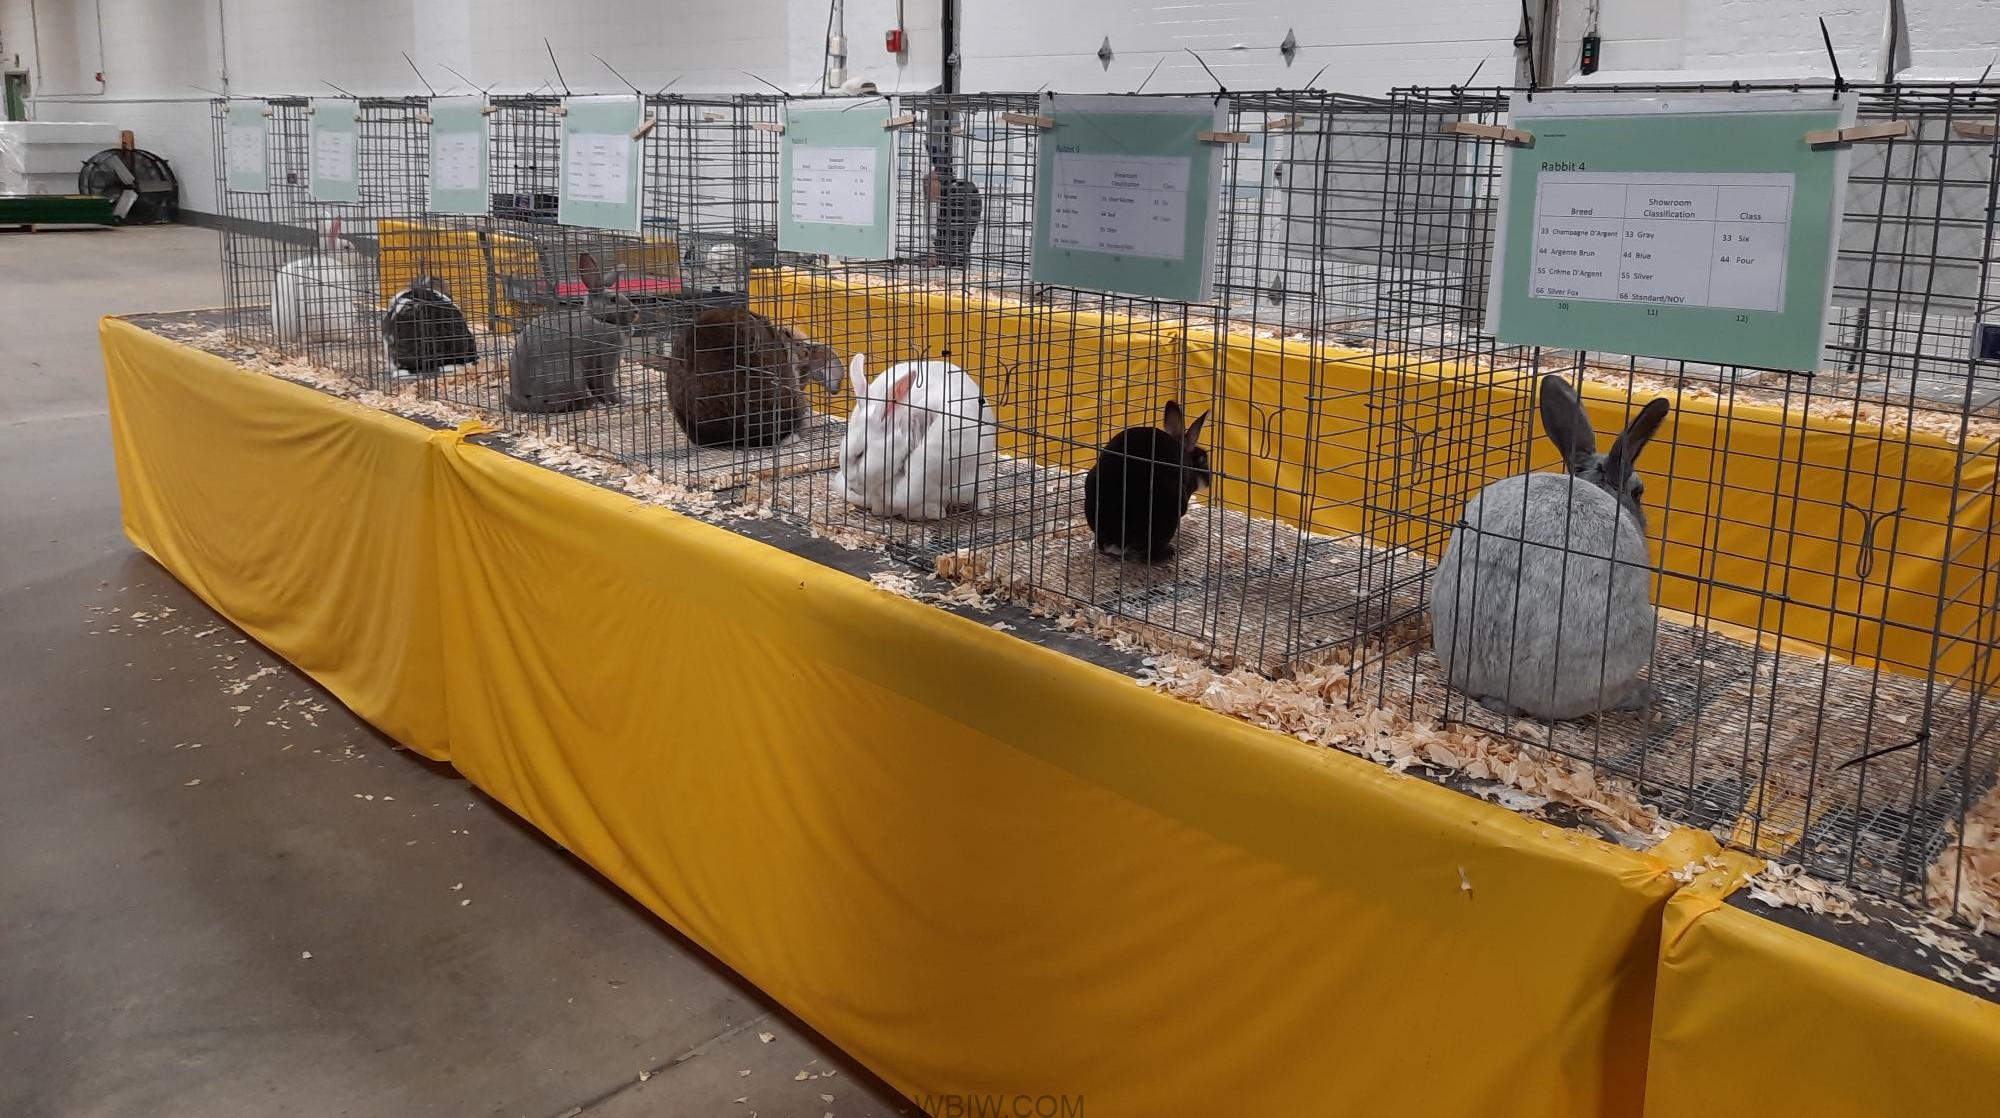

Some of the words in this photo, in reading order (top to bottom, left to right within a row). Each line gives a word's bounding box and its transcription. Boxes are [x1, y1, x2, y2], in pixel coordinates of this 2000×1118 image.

[1541, 162, 1576, 172] Rabbit
[1578, 162, 1585, 172] 4
[1649, 198, 1692, 207] Showroom
[1644, 210, 1696, 219] Classification
[1740, 212, 1761, 220] Class
[1590, 230, 1618, 238] D'Argent
[1637, 231, 1655, 239] Gray
[1722, 234, 1732, 242] 33
[1573, 269, 1603, 278] D'Argent
[1634, 272, 1653, 280] Silver
[1632, 293, 1685, 303] Standard/NOV
